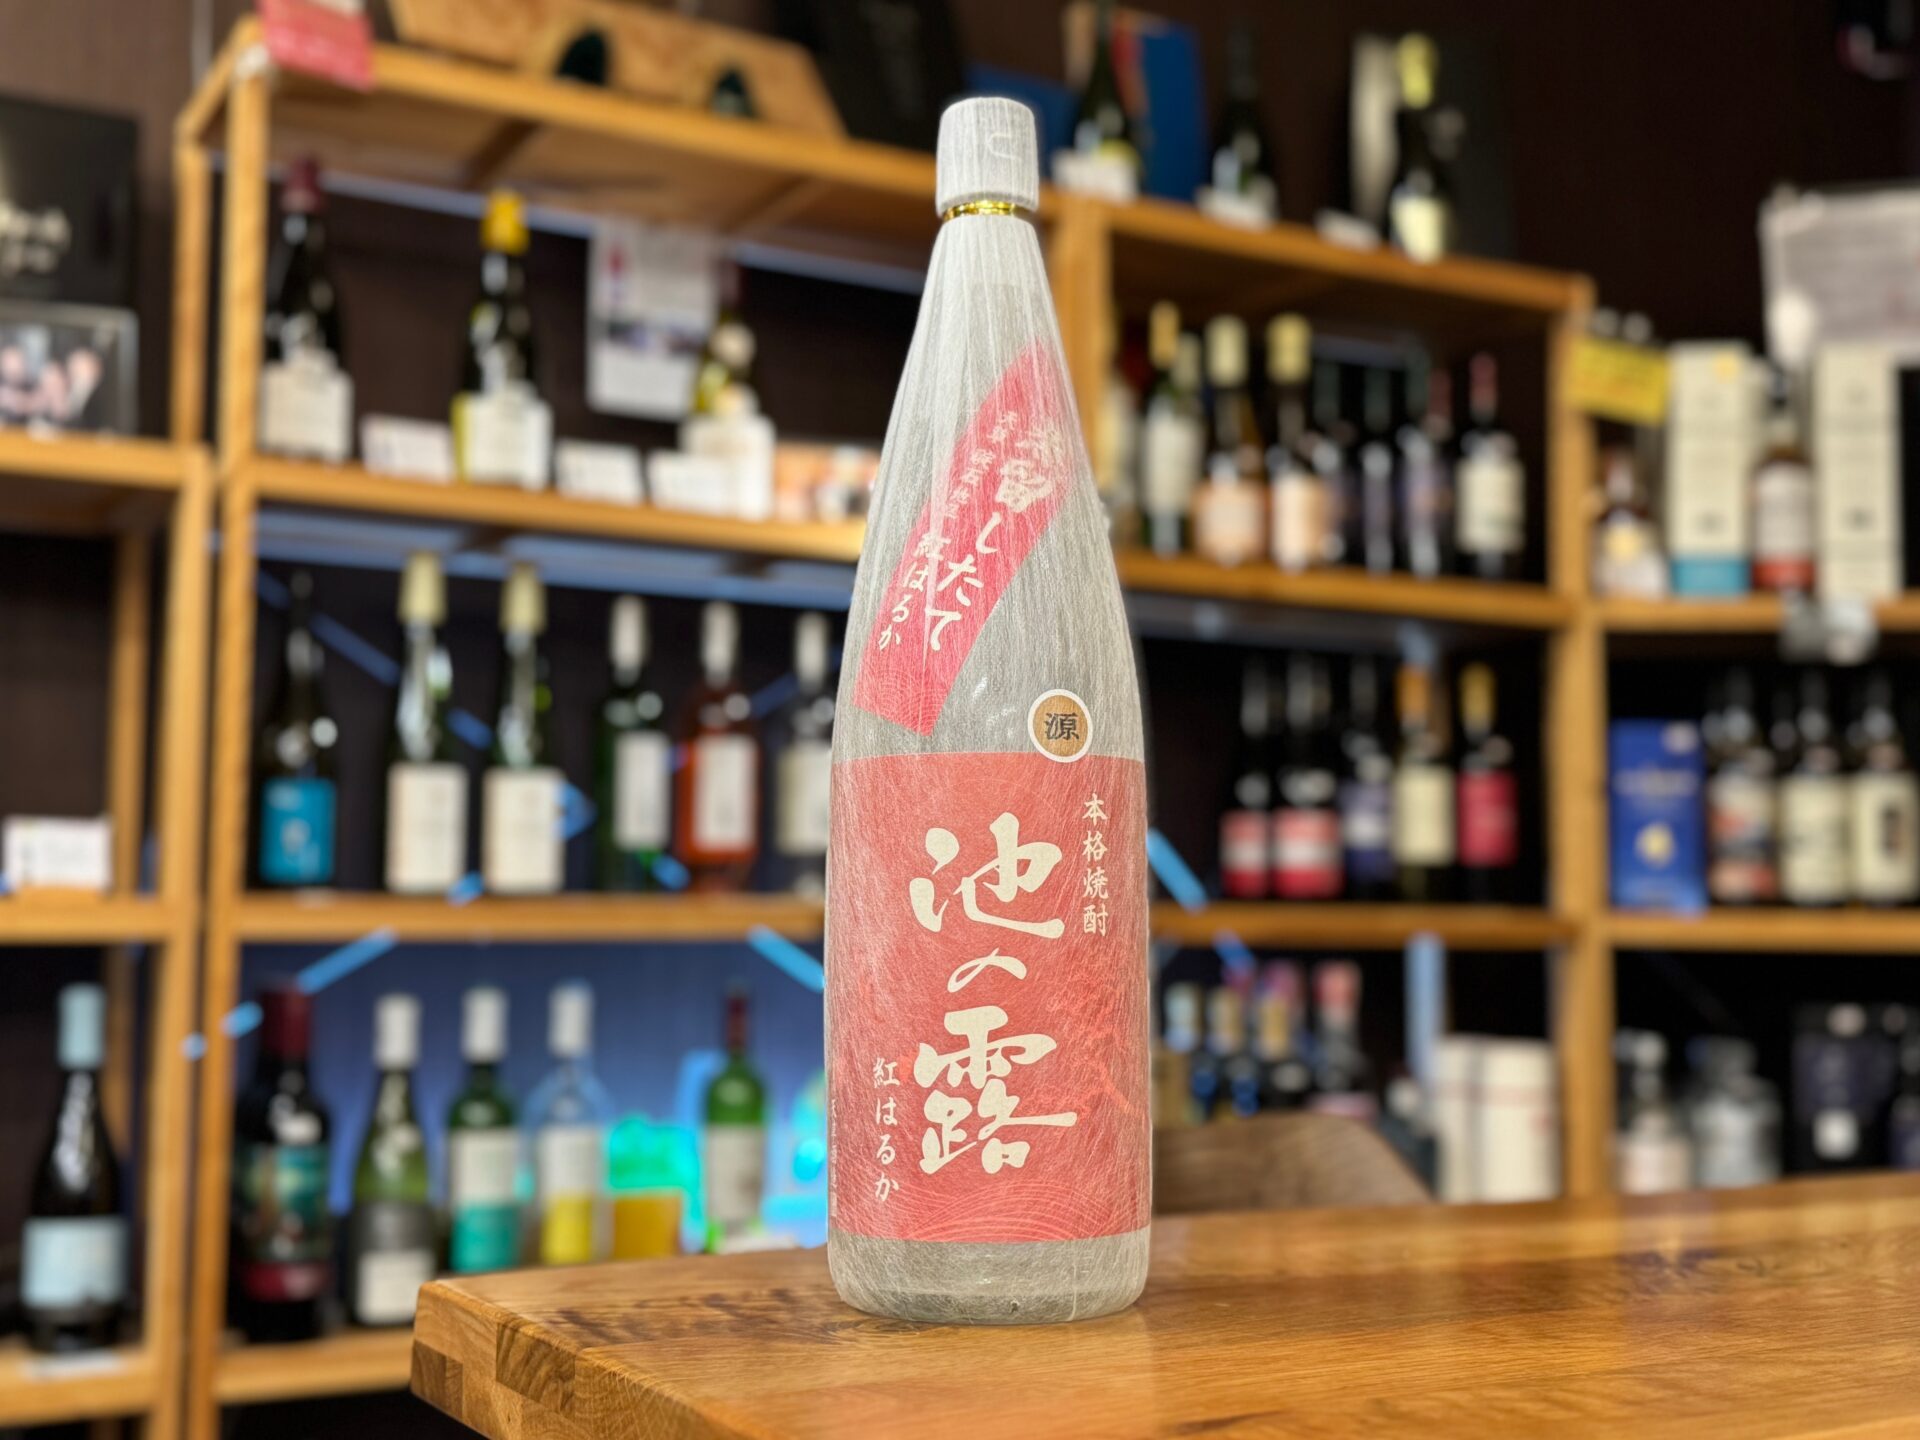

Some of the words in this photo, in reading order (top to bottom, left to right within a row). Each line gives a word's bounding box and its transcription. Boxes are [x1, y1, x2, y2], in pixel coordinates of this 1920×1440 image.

[878, 532, 951, 651] 紅はるか
[1044, 712, 1080, 741] 源
[1082, 793, 1109, 937] 本格焼酎
[909, 812, 1077, 1175] 池の露
[873, 1057, 901, 1202] 紅はるか
